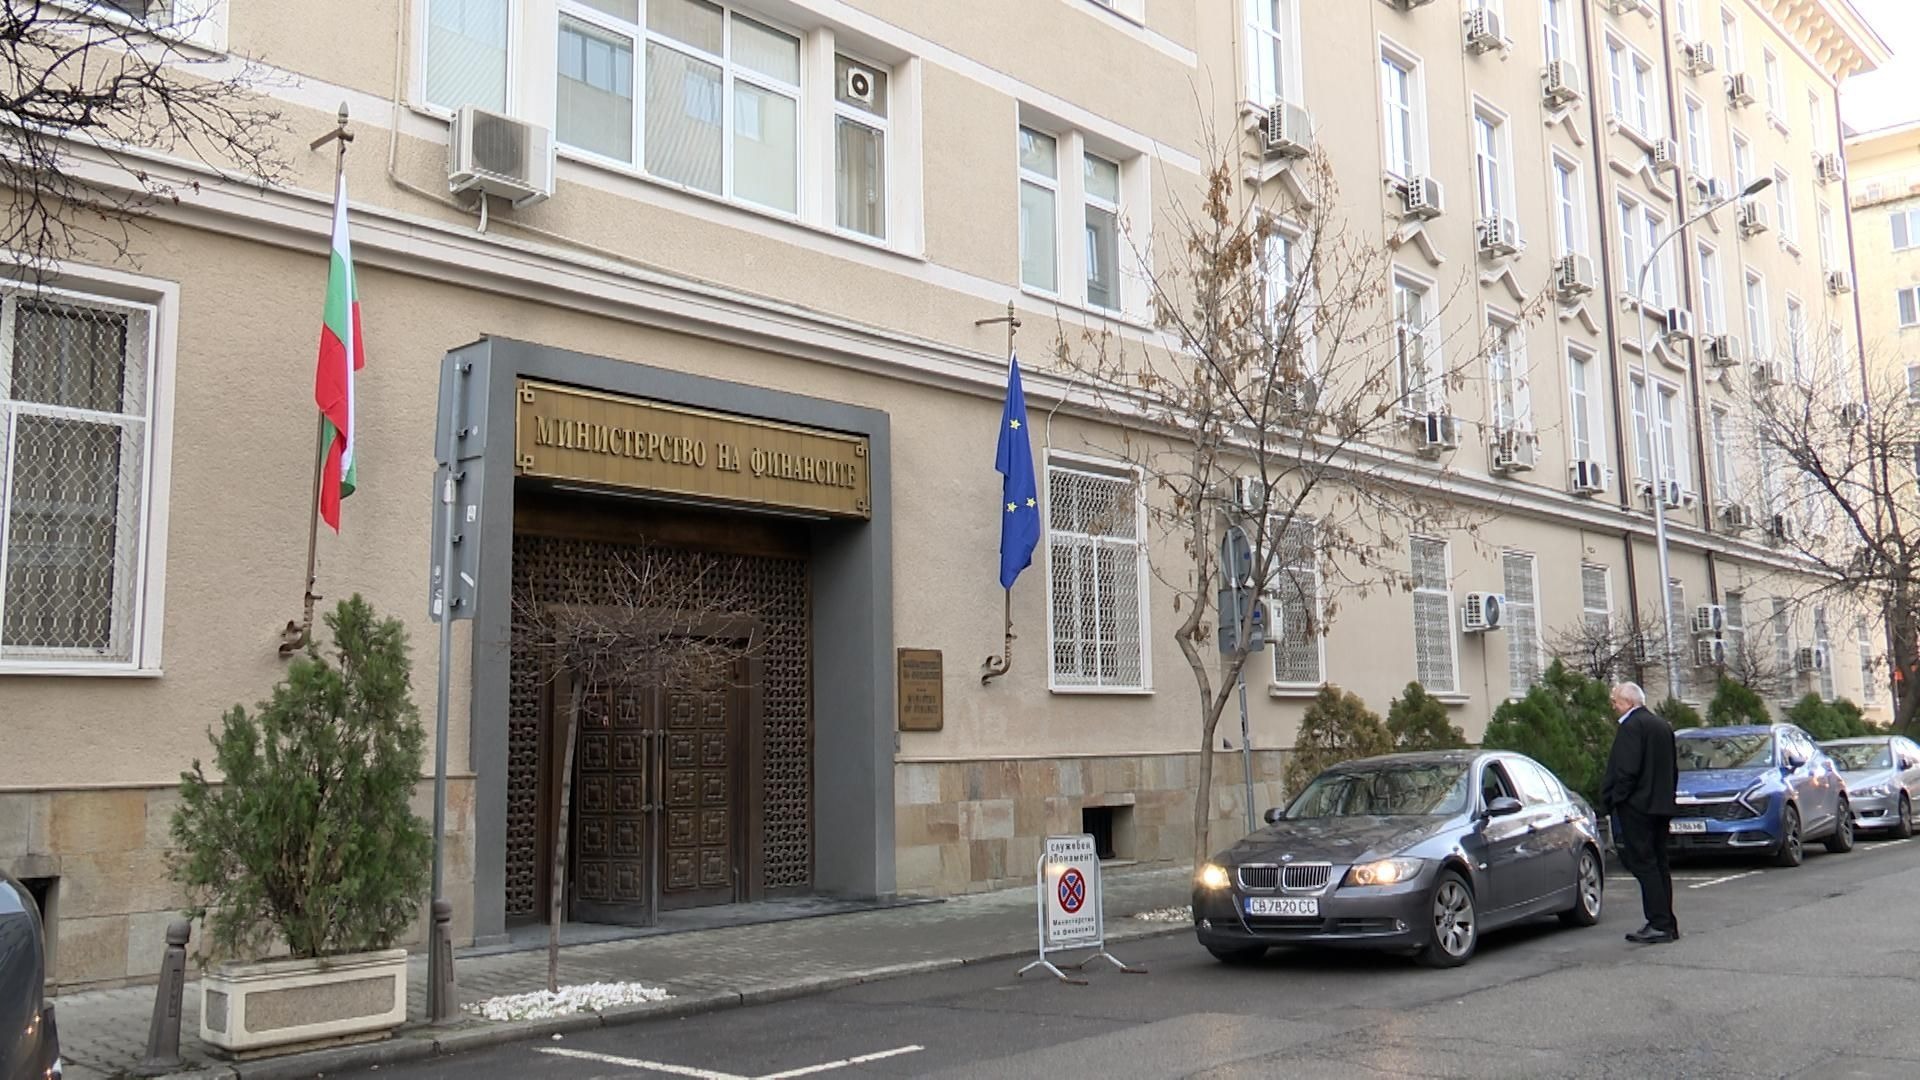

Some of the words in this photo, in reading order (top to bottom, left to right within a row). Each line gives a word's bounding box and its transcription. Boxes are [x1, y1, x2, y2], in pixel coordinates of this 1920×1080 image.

[535, 415, 707, 468] МИНИСТЕРСТВО
[717, 442, 742, 474] НА
[750, 447, 857, 490] ФИНАНСИТЕ
[1269, 900, 1297, 913] 7820
